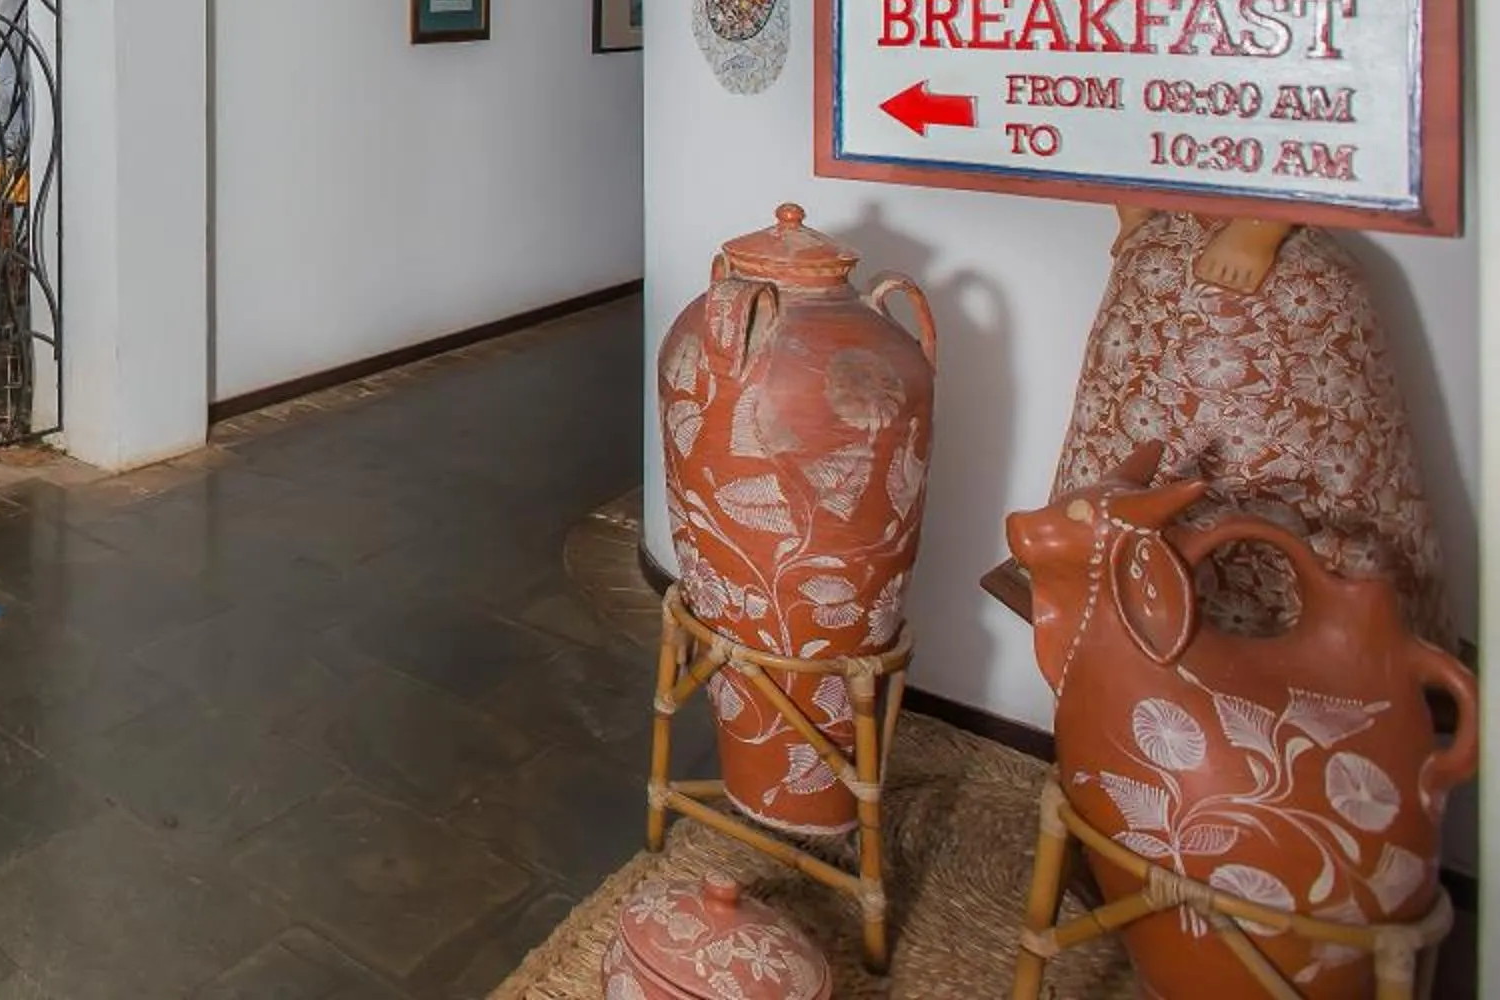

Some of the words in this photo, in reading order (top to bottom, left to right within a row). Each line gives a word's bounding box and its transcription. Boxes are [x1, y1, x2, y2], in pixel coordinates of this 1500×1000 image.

[1004, 73, 1125, 111] FROM
[1143, 79, 1263, 119] 08:00
[1269, 86, 1358, 123] AM
[1004, 123, 1061, 157] TO
[1149, 131, 1263, 174] 10:30
[1272, 139, 1359, 182] AM
